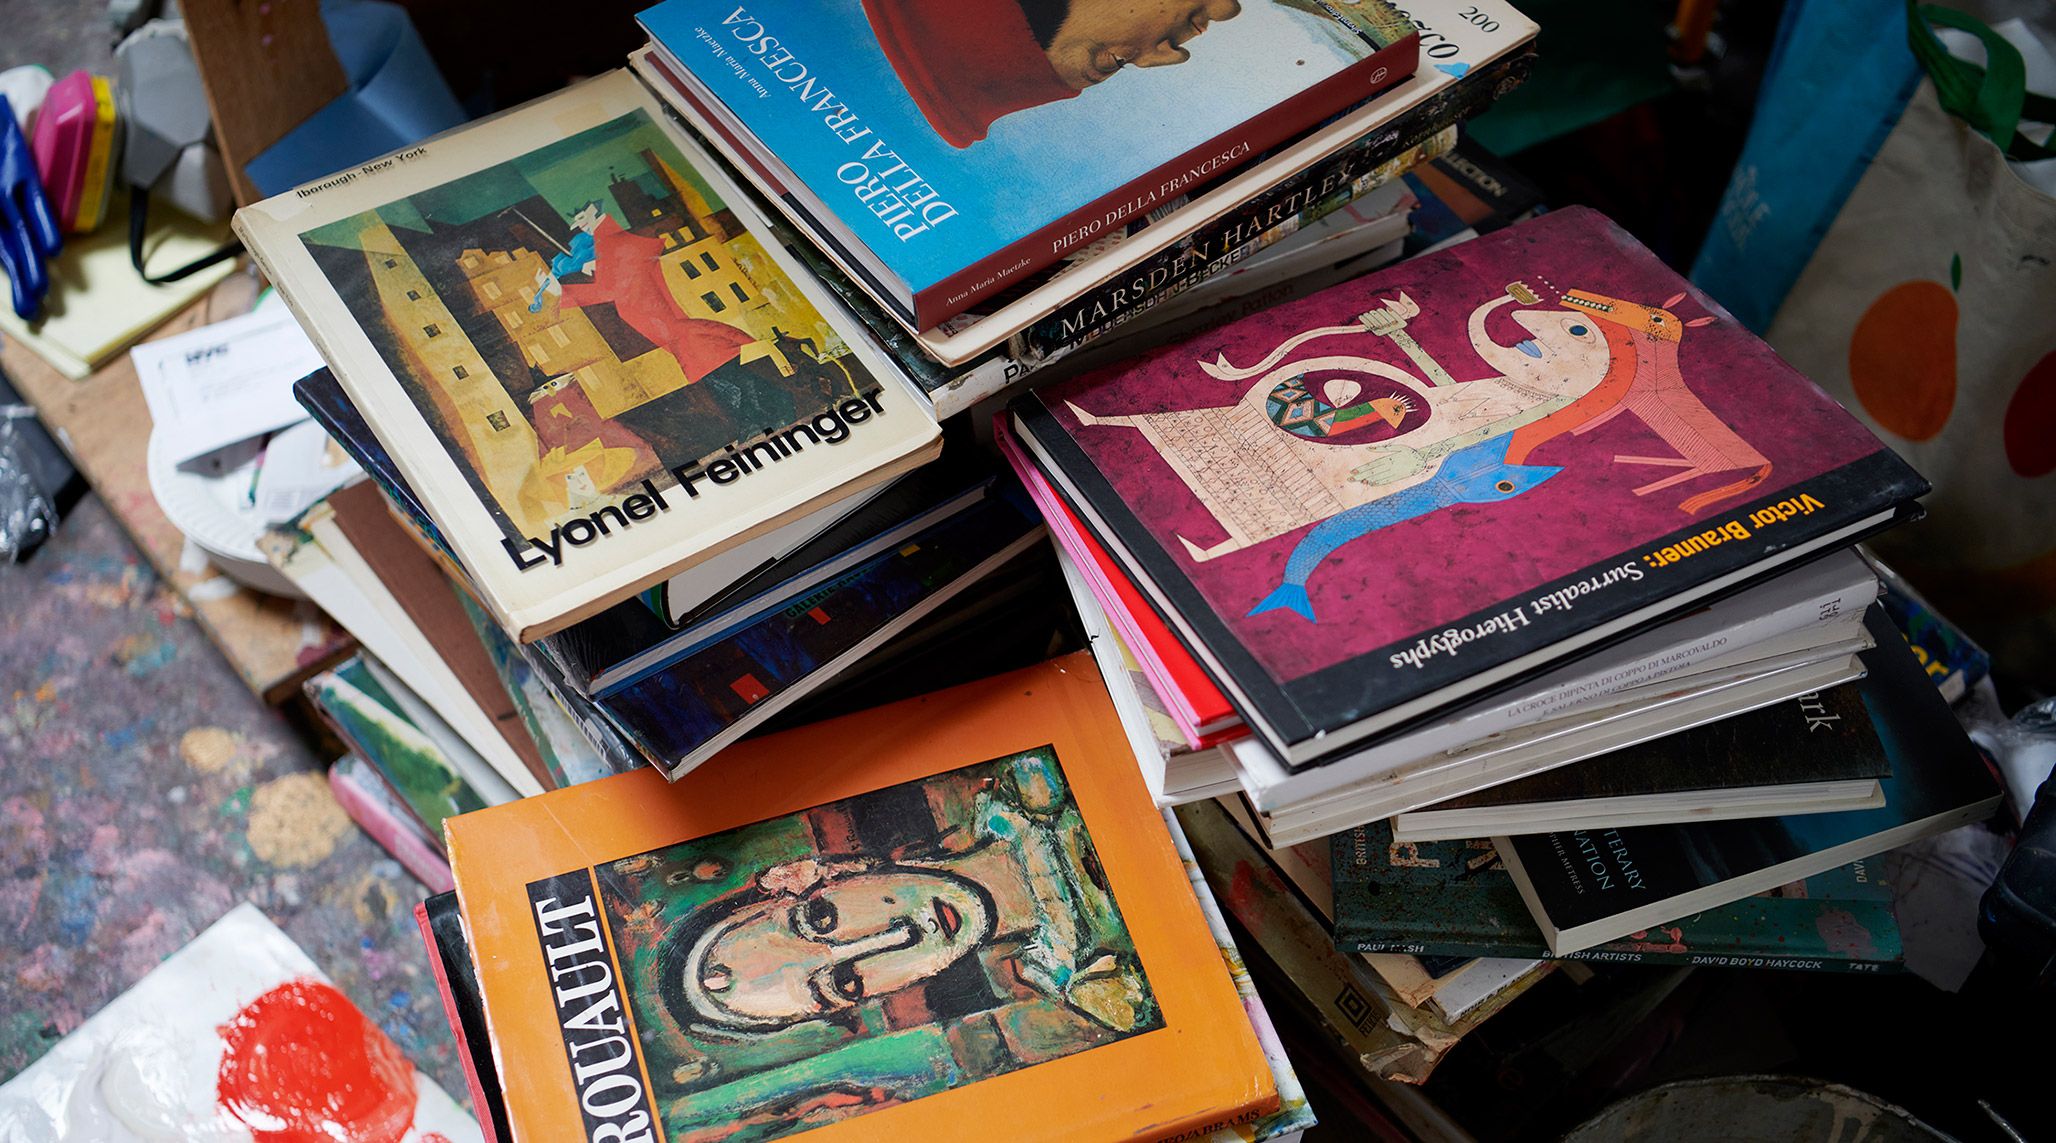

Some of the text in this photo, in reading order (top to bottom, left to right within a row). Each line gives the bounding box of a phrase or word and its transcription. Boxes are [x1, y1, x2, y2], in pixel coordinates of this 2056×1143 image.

[1458, 6, 1500, 33] 200
[694, 26, 771, 100] Anna Maria Maetzke
[395, 146, 427, 162] York
[721, 5, 959, 228] DELLA FRANCESCA
[836, 161, 930, 243] PIERO
[946, 140, 1250, 307] Anna Maria Maetzke PIERO DELLA FRANCESCA
[1061, 162, 1356, 339] MARSDEN HARTLEY
[500, 387, 886, 571] Lyonel Feininger
[1389, 493, 1825, 669] Victor Brauner: Surrealist Hieroglyphs
[1508, 637, 1728, 717] LA CROCE DIPINTA DI COPPO DI MARCOVALDO
[1603, 828, 1646, 891] TERARY
[1592, 952, 1642, 962] ARTISTS
[1692, 955, 1728, 966] DAVID
[1730, 956, 1763, 967] BOYD
[1766, 958, 1823, 969] HAYCOCK
[1850, 963, 1879, 972] TATE
[535, 895, 653, 1143] ROUAULT
